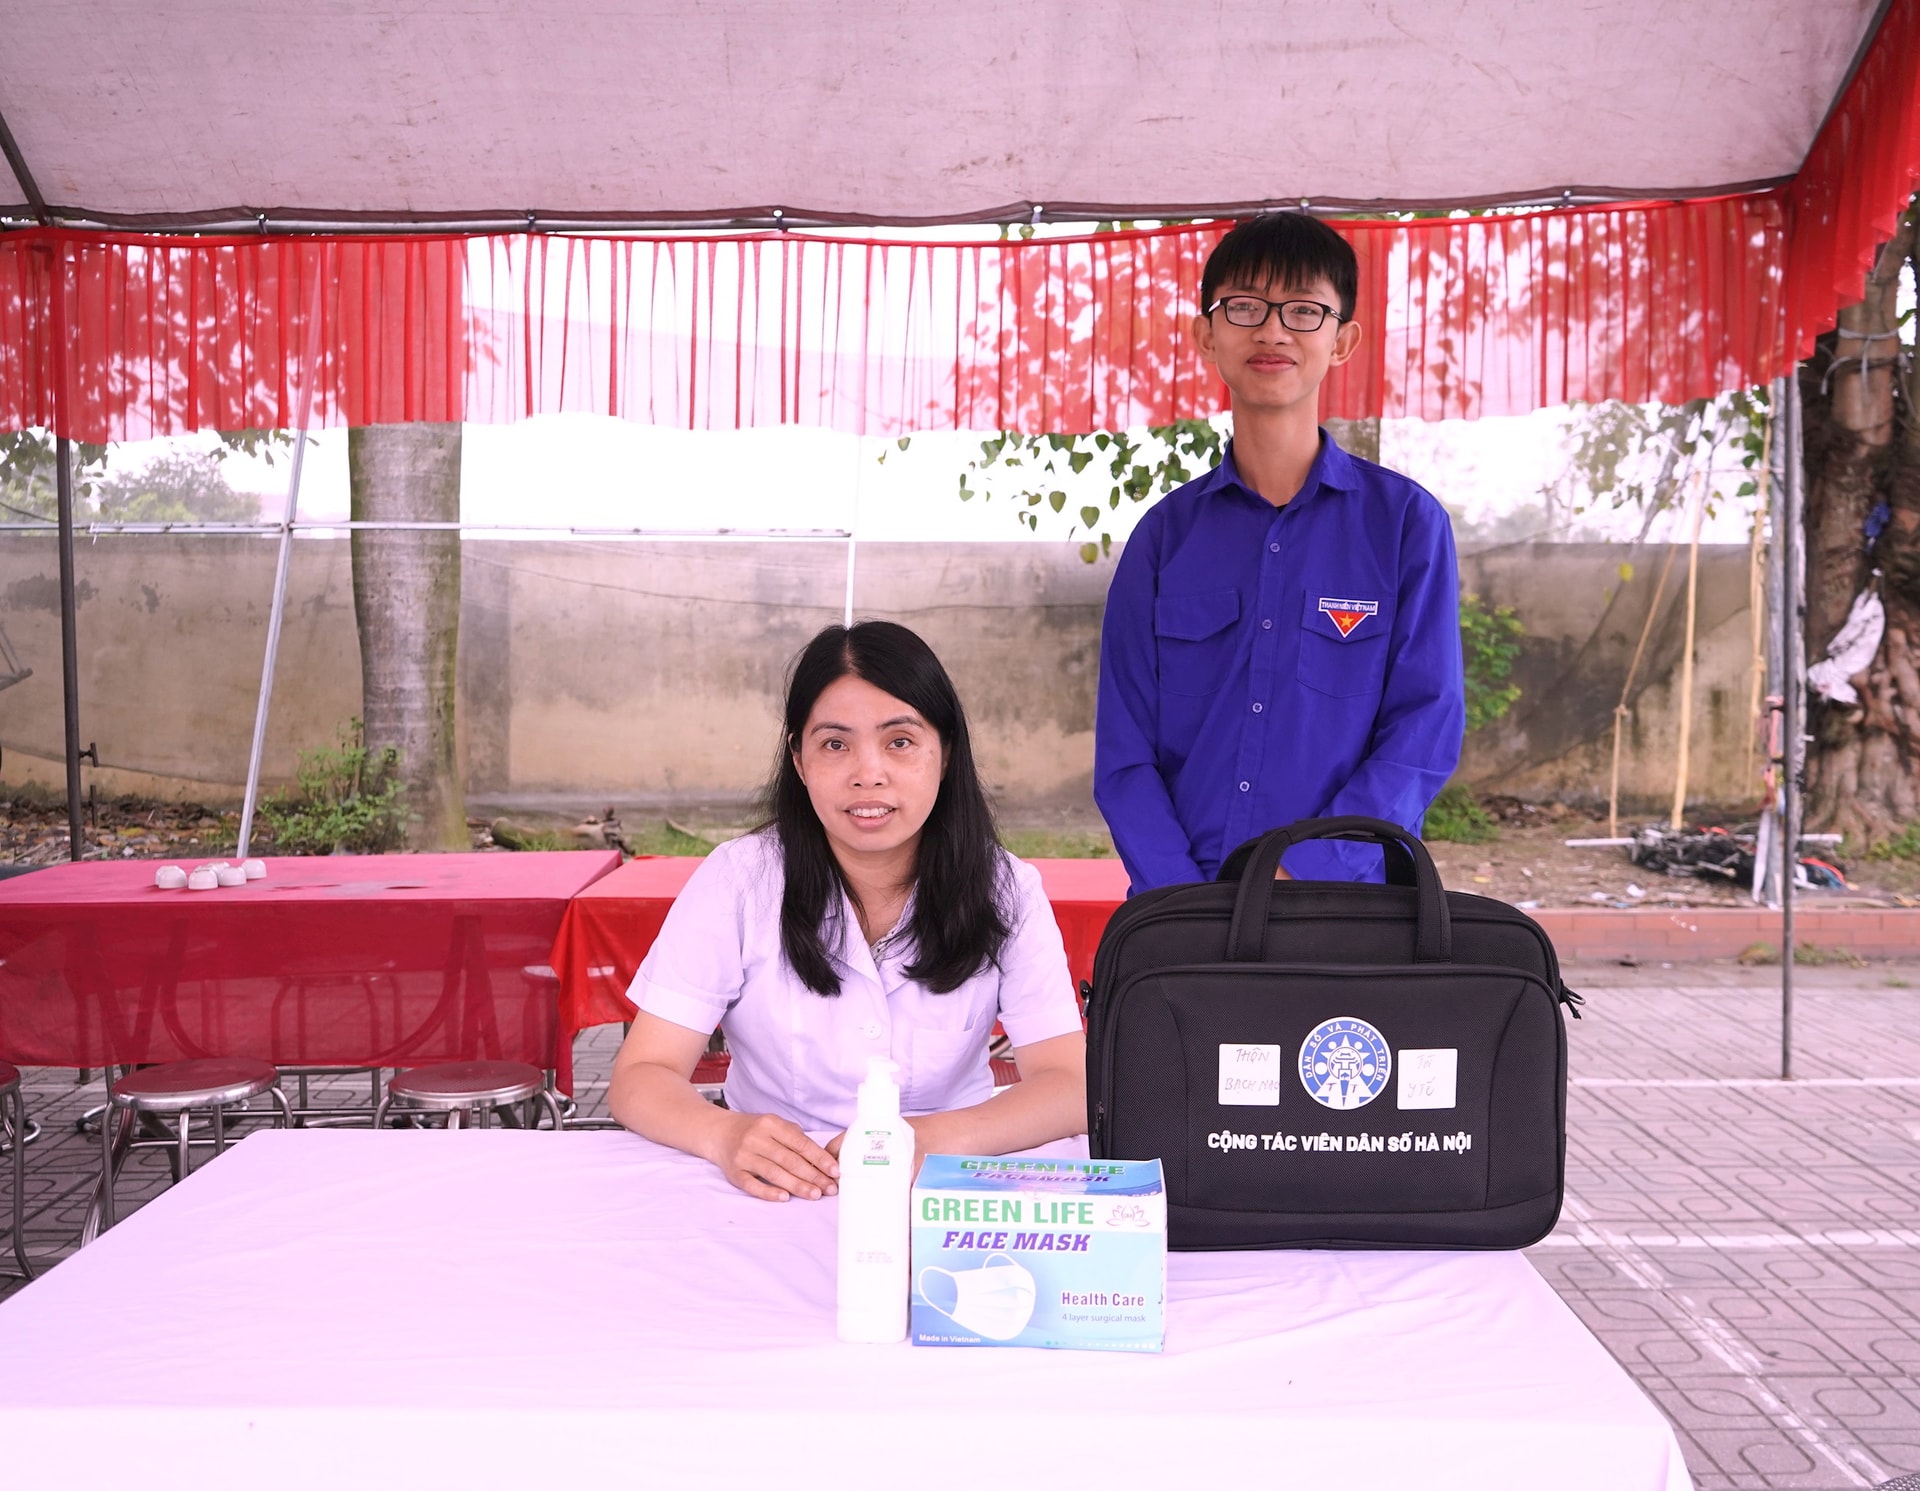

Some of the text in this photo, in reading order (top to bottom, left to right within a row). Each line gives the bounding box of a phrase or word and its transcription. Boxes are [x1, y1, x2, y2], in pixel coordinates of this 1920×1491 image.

[1303, 1056, 1313, 1079] DÂN
[1327, 1022, 1342, 1033] VÀ
[1350, 1023, 1377, 1042] PHÁT
[1207, 1130, 1472, 1155] CỘNG TÁC VIÊN DÂN SỐ HÀ NỘI
[960, 1160, 1126, 1175] GREEN LIFE
[922, 1197, 1094, 1225] GREEN LIFE
[942, 1231, 1091, 1252] FACE MASK
[1062, 1292, 1145, 1307] Health Care
[1069, 1313, 1089, 1323] layer
[1091, 1314, 1122, 1324] surgical
[919, 1334, 940, 1342] Made
[949, 1335, 981, 1343] Vietnam
